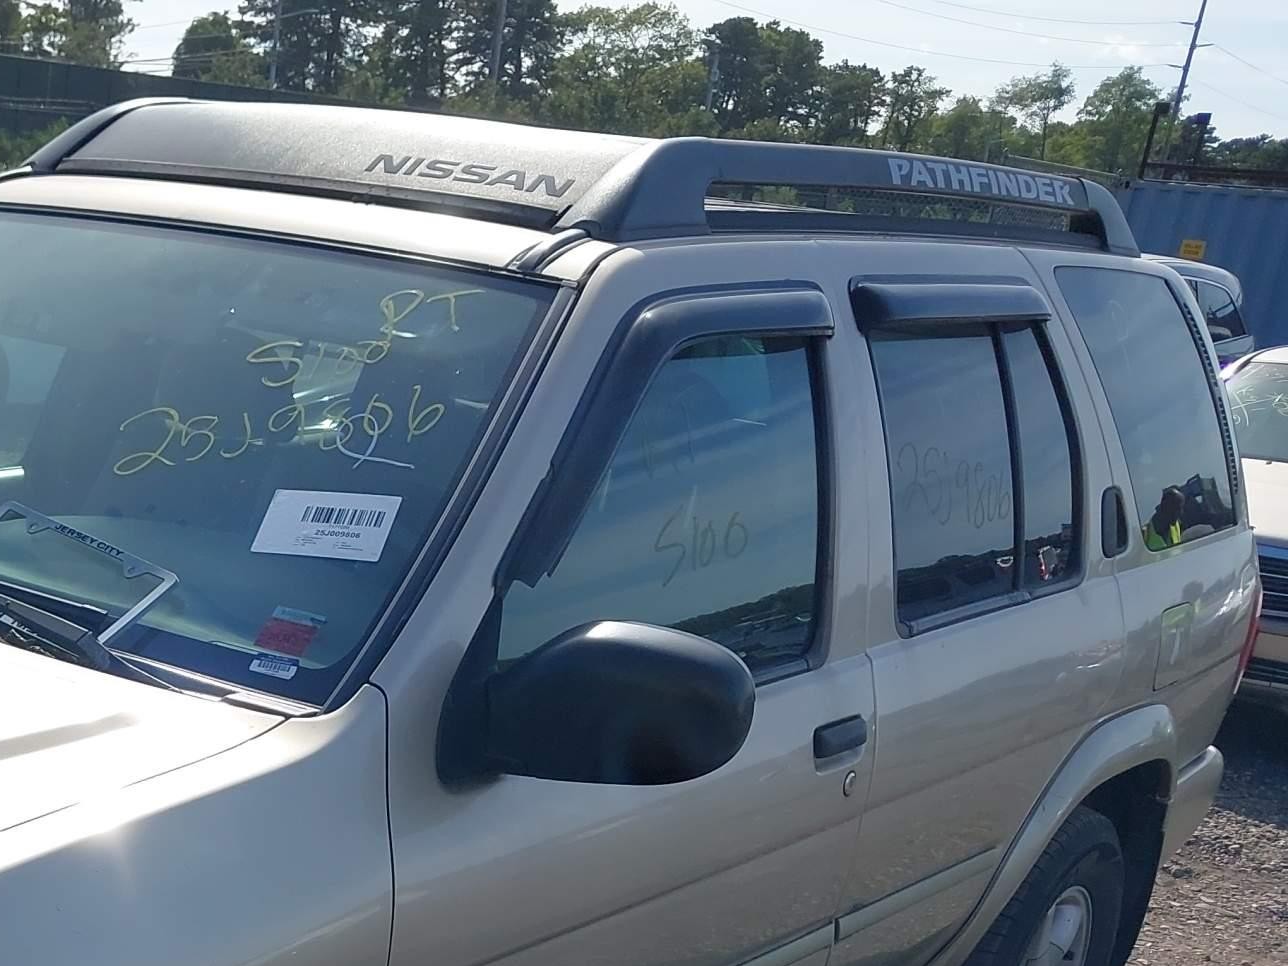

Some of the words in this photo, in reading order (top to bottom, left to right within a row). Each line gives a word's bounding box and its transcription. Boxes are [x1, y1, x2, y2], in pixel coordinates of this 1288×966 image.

[364, 153, 576, 198] NISSAN
[887, 158, 1075, 206] PATHFINDER
[54, 523, 98, 548] JERSEY
[96, 541, 124, 557] CITY
